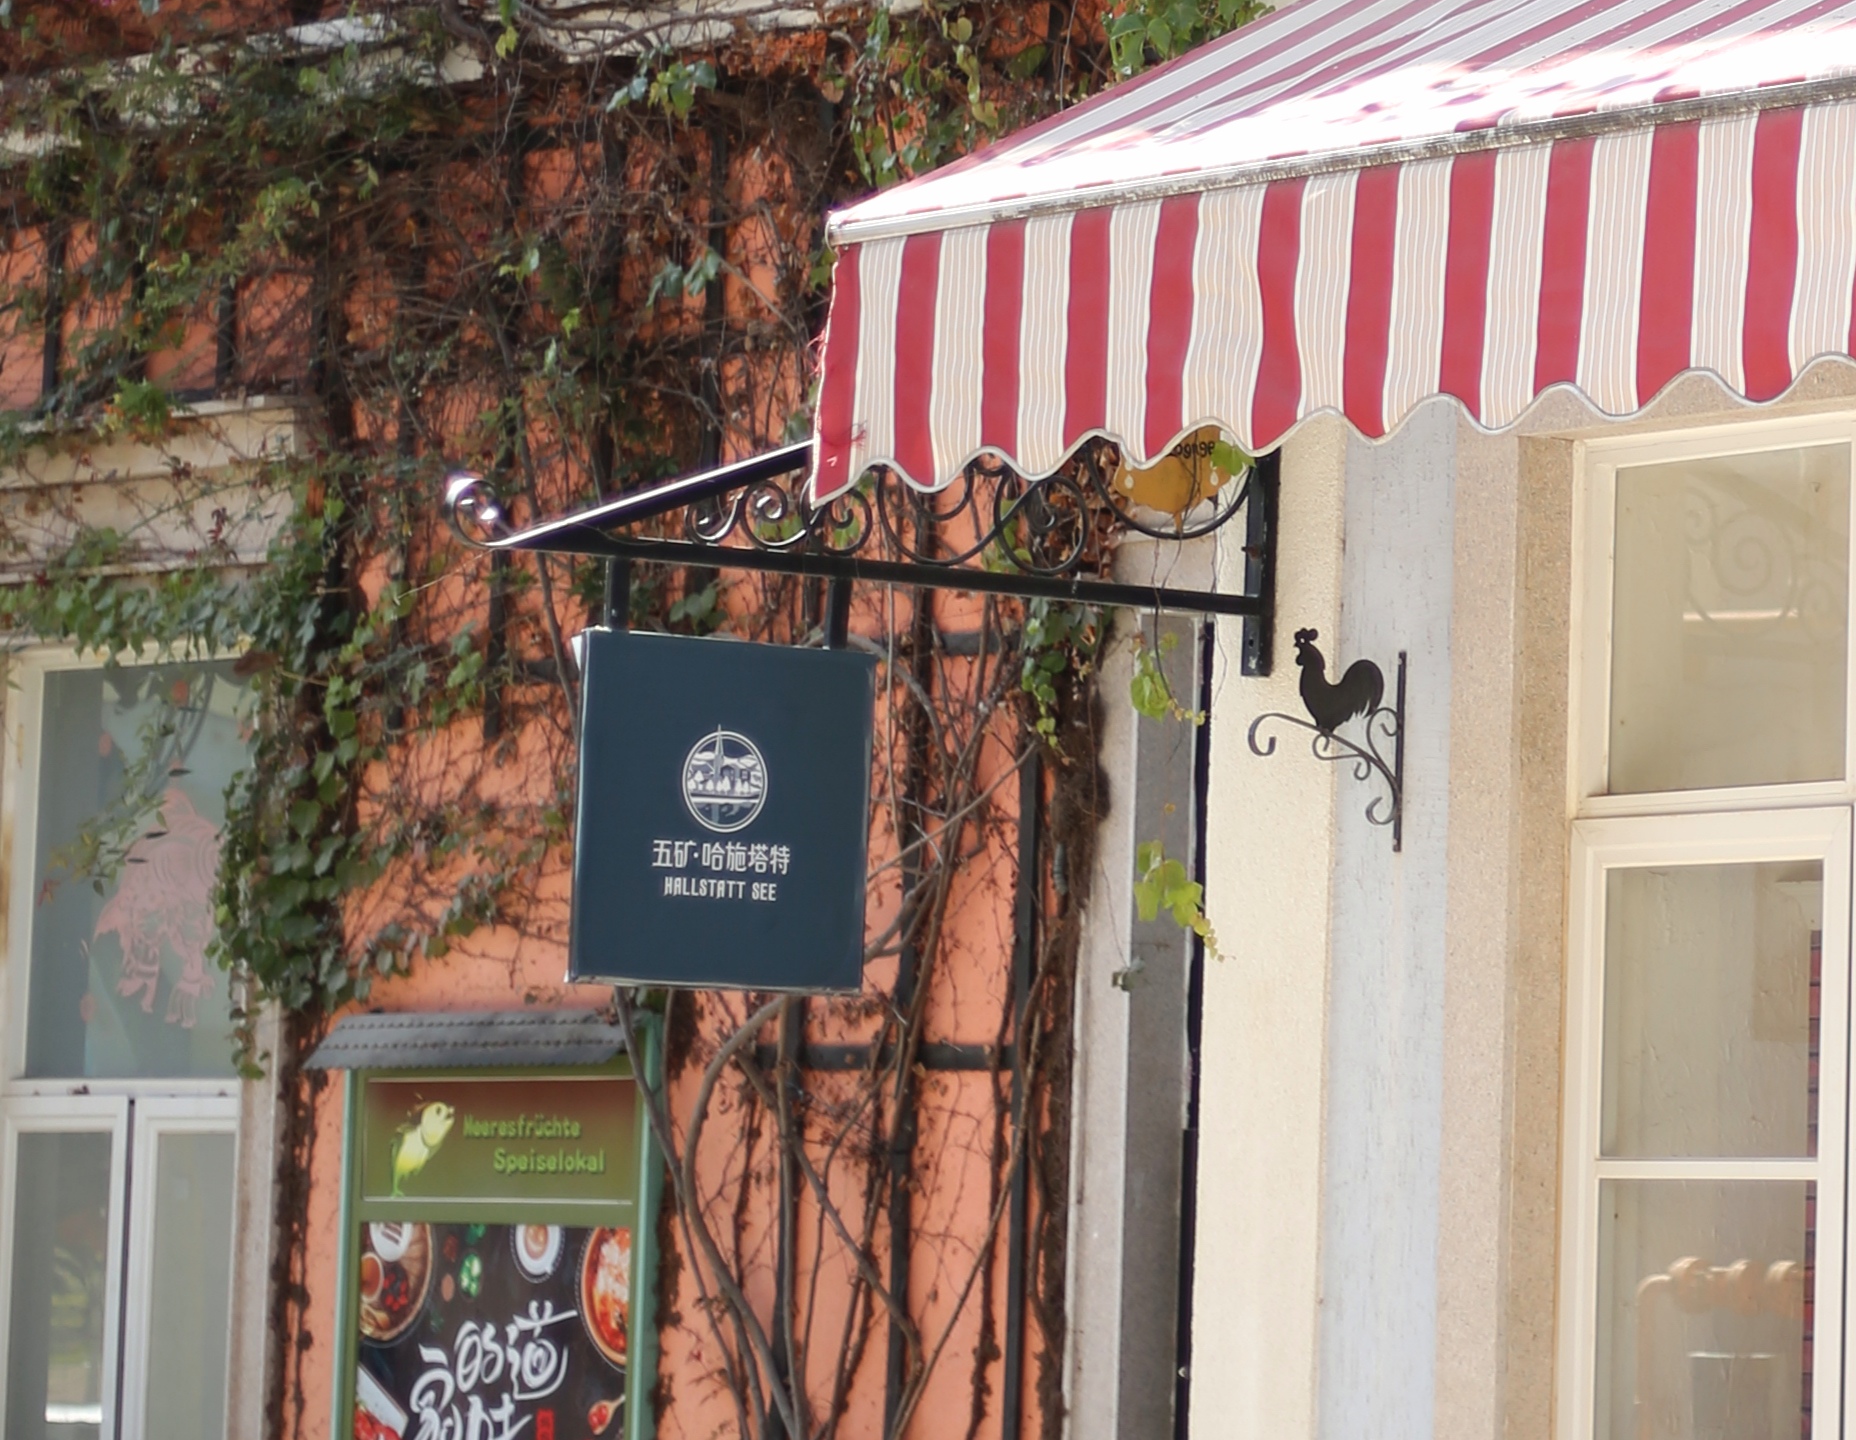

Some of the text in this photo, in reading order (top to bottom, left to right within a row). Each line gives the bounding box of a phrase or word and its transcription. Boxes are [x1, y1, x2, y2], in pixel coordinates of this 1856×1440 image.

[652, 839, 791, 875] 五矿·哈施塔特
[664, 876, 777, 901] HALLSTATT SEE
[494, 1146, 606, 1174] Speiselokal
